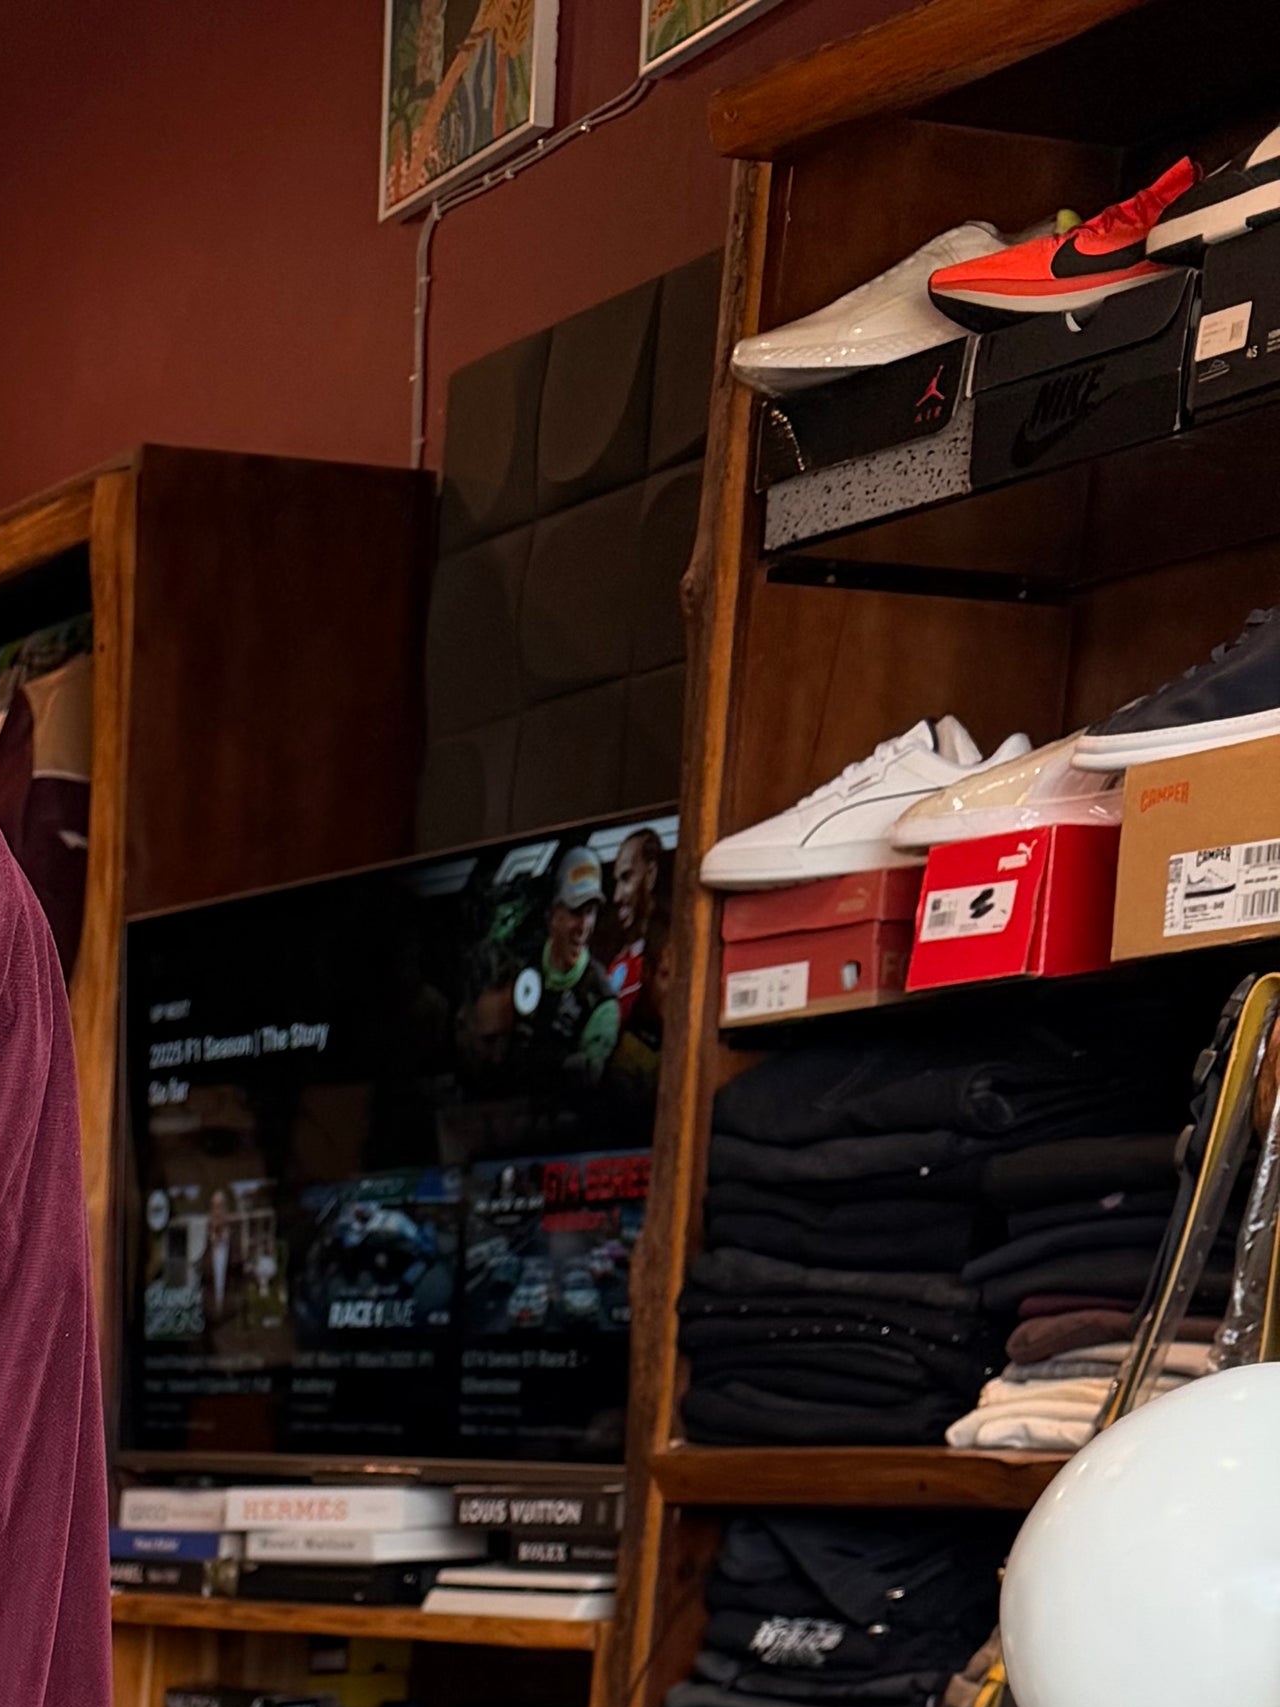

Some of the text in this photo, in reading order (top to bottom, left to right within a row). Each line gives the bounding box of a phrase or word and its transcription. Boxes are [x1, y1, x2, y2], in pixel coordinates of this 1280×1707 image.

[1030, 365, 1104, 425] NIKE
[1141, 781, 1190, 813] CAMPER
[1196, 846, 1232, 868] CAMPER
[459, 1499, 584, 1525] LOUIS VUITTON
